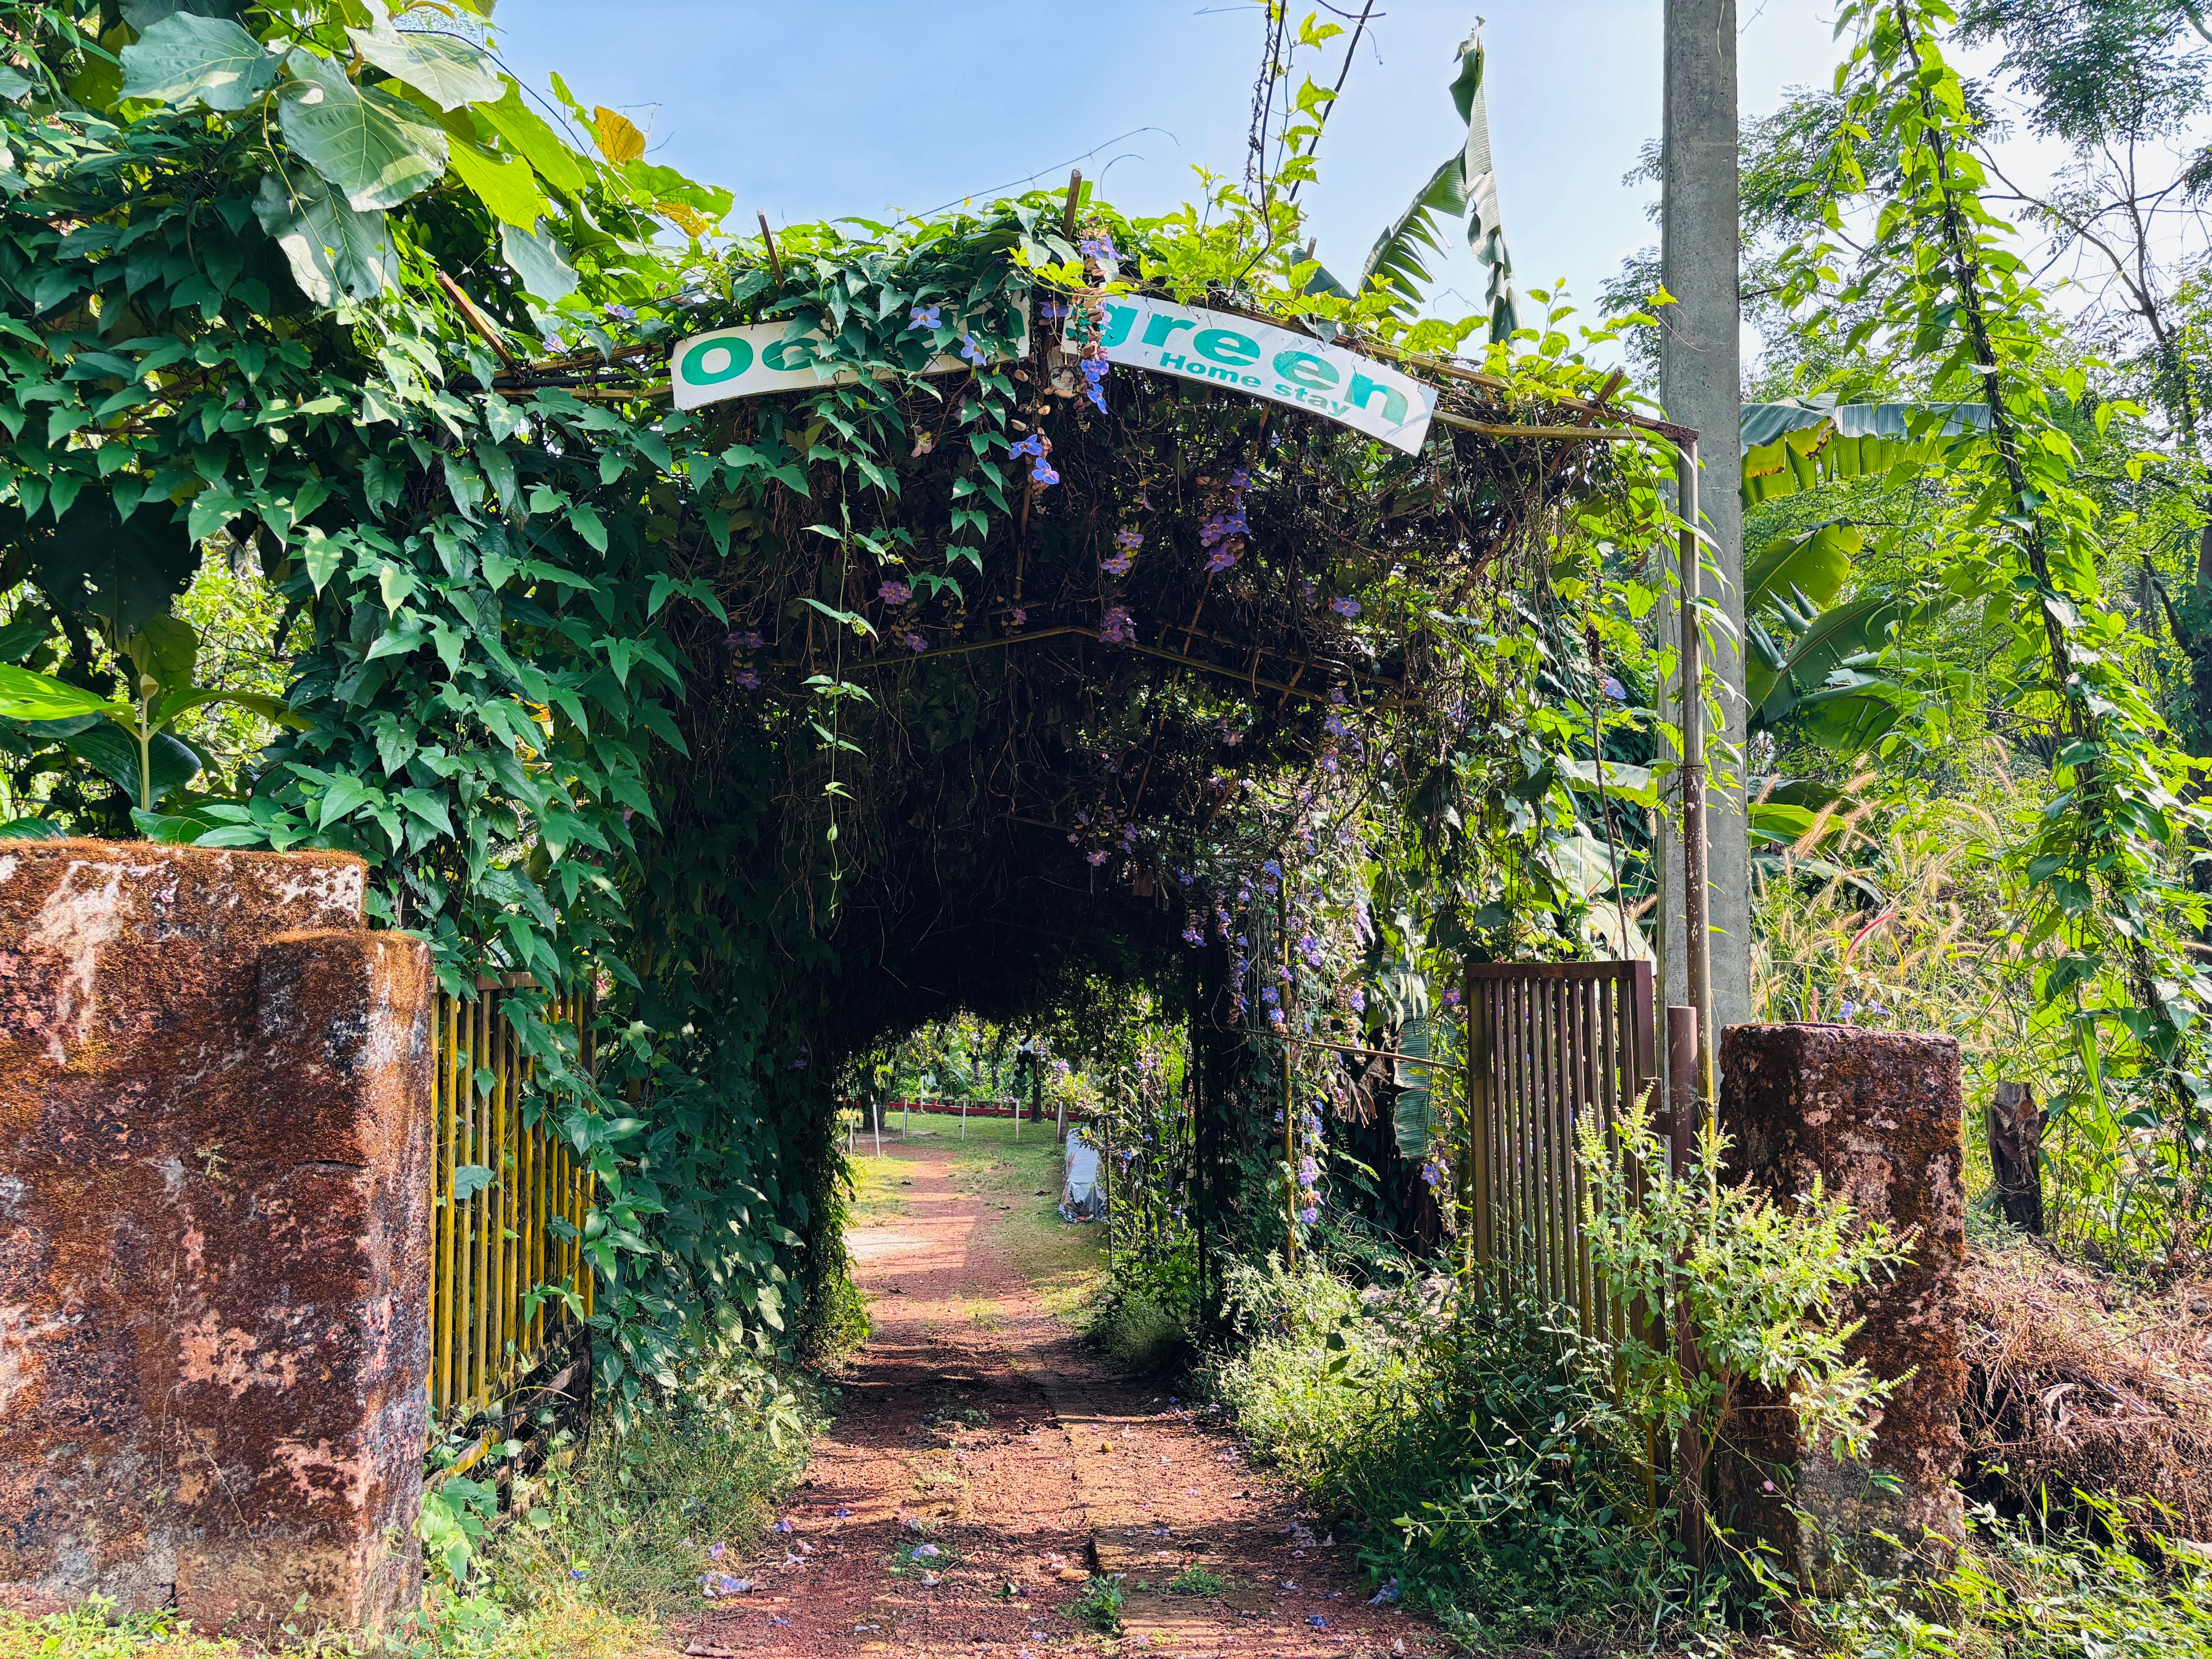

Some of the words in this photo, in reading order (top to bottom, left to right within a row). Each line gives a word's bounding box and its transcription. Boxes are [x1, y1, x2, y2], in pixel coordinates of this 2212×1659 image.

[1066, 303, 1409, 426] green
[1159, 352, 1261, 388] Home
[1273, 383, 1350, 417] stay
